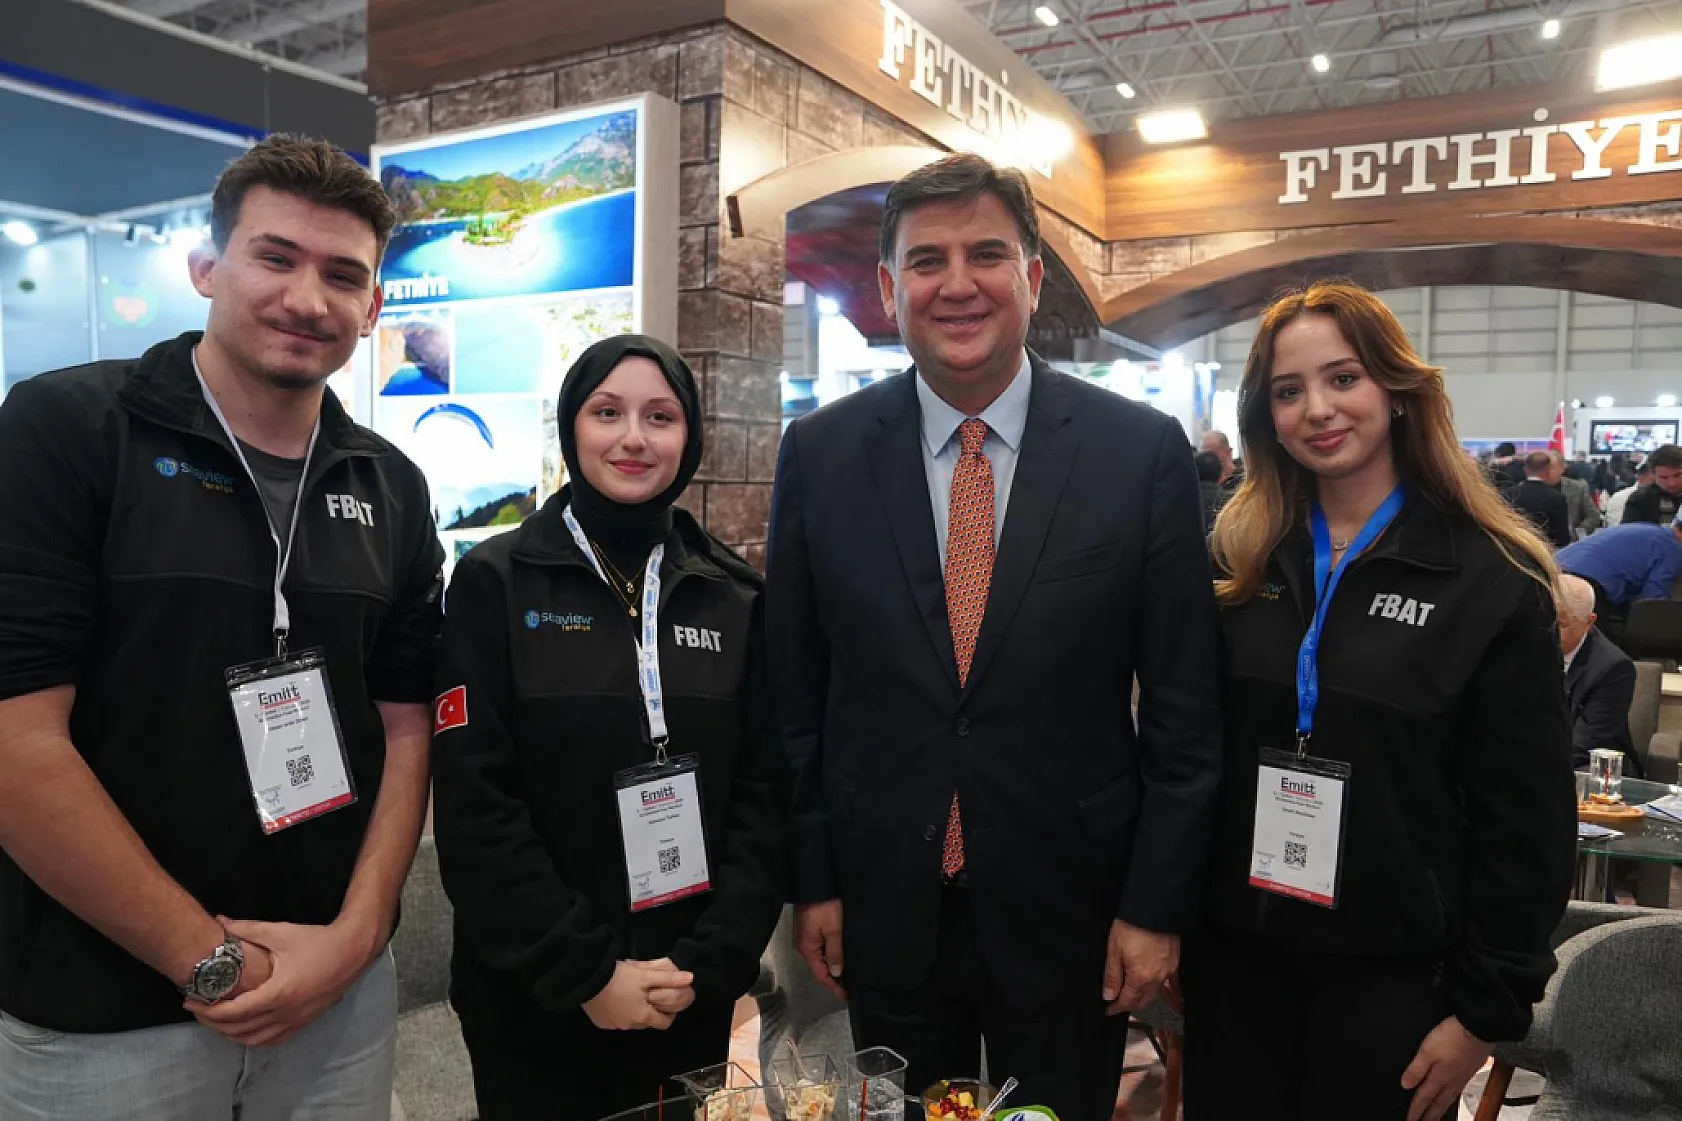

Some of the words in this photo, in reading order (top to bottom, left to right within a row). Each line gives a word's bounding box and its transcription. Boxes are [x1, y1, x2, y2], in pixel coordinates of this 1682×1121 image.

[1278, 107, 1682, 205] FETHİYE
[325, 493, 375, 527] FBAT
[1368, 592, 1436, 627] FBAT
[673, 624, 722, 653] FBAT
[641, 785, 676, 803] Emitt
[1281, 777, 1317, 795] Emitt
